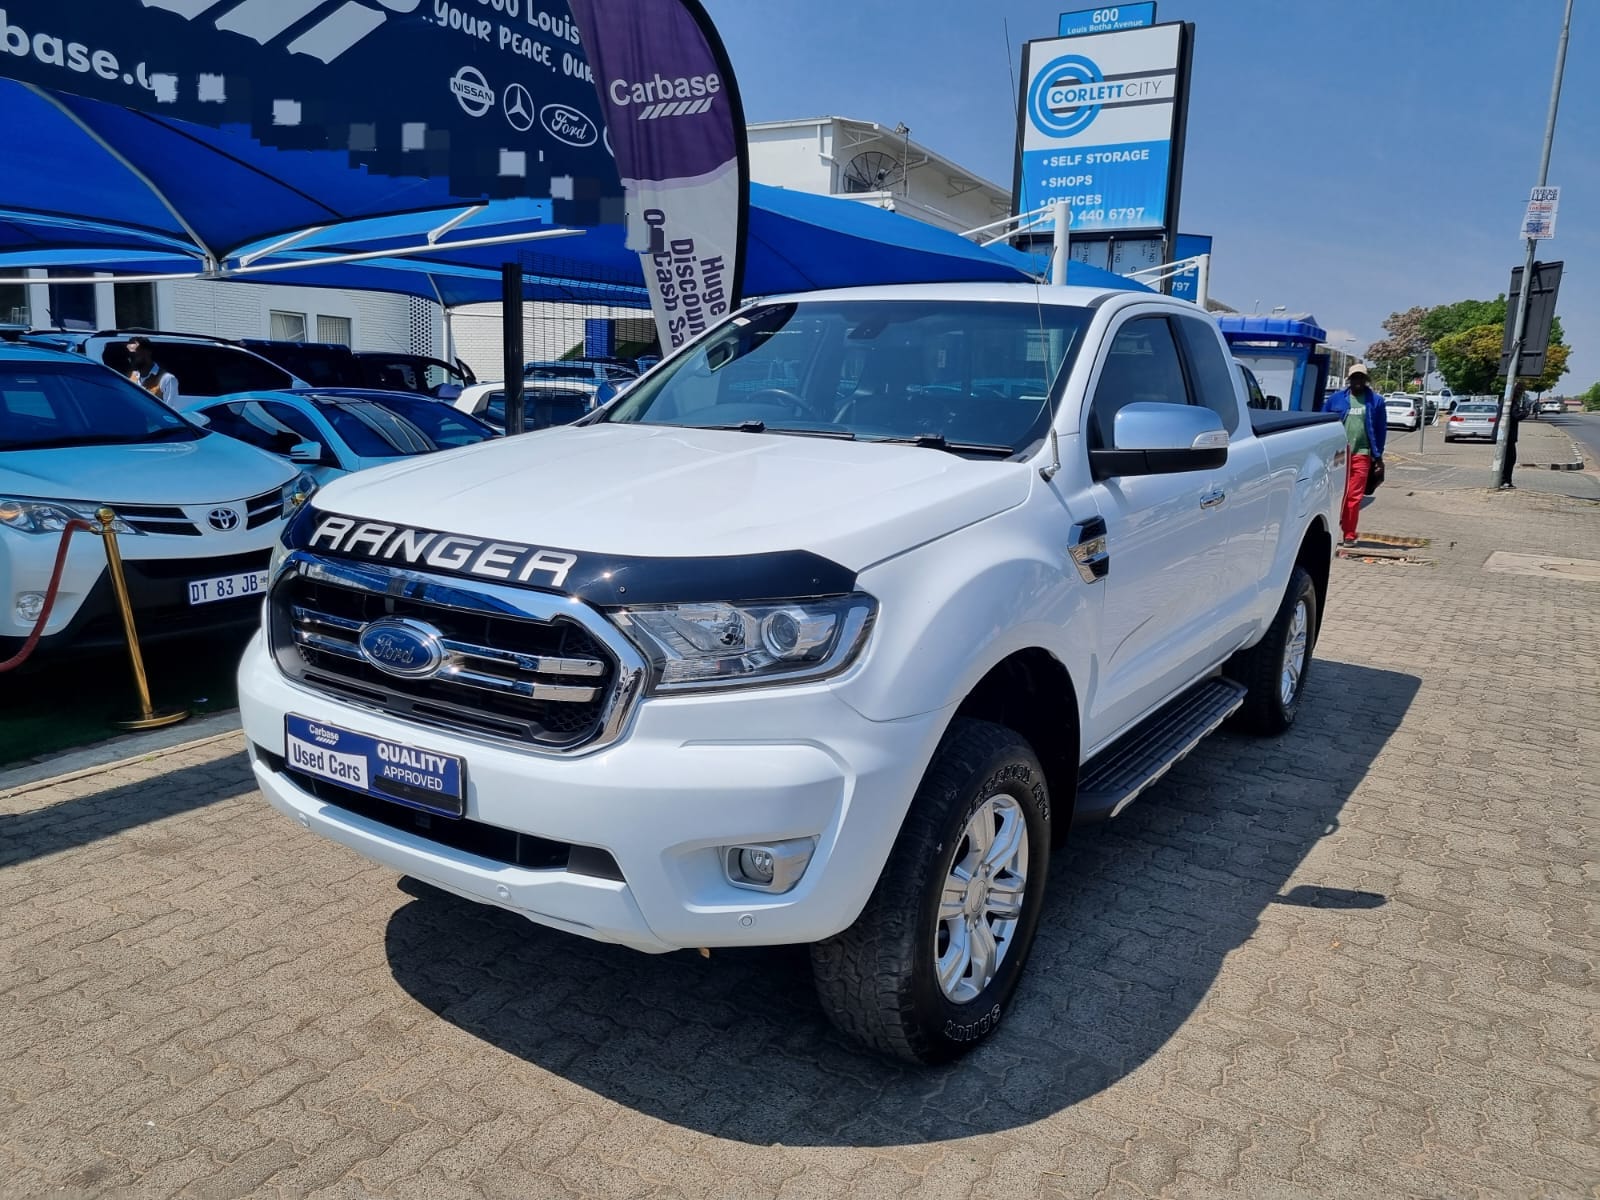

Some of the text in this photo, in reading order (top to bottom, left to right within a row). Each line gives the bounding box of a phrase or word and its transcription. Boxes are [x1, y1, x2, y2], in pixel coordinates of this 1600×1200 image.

[1067, 19, 1144, 36] Louis Botha Avenue
[1092, 8, 1119, 24] 600
[500, 25, 556, 73] PEACE,
[453, 81, 492, 101] NISSAN
[609, 73, 720, 106] Carbase
[551, 109, 588, 140] Ford
[1050, 150, 1149, 167] SELF STORAGE
[1049, 175, 1093, 188] SHOPS
[1078, 209, 1104, 222] 440
[1109, 207, 1145, 220] 6797
[653, 251, 680, 312] Cash
[700, 255, 727, 317] Huge
[308, 516, 578, 587] RANGER
[191, 574, 258, 602] DT 83 JB
[373, 633, 415, 664] Ford
[309, 724, 340, 741] Carbase
[293, 742, 361, 782] Used Cars
[376, 743, 447, 775] QUALITY
[383, 765, 443, 791] APPROVED
